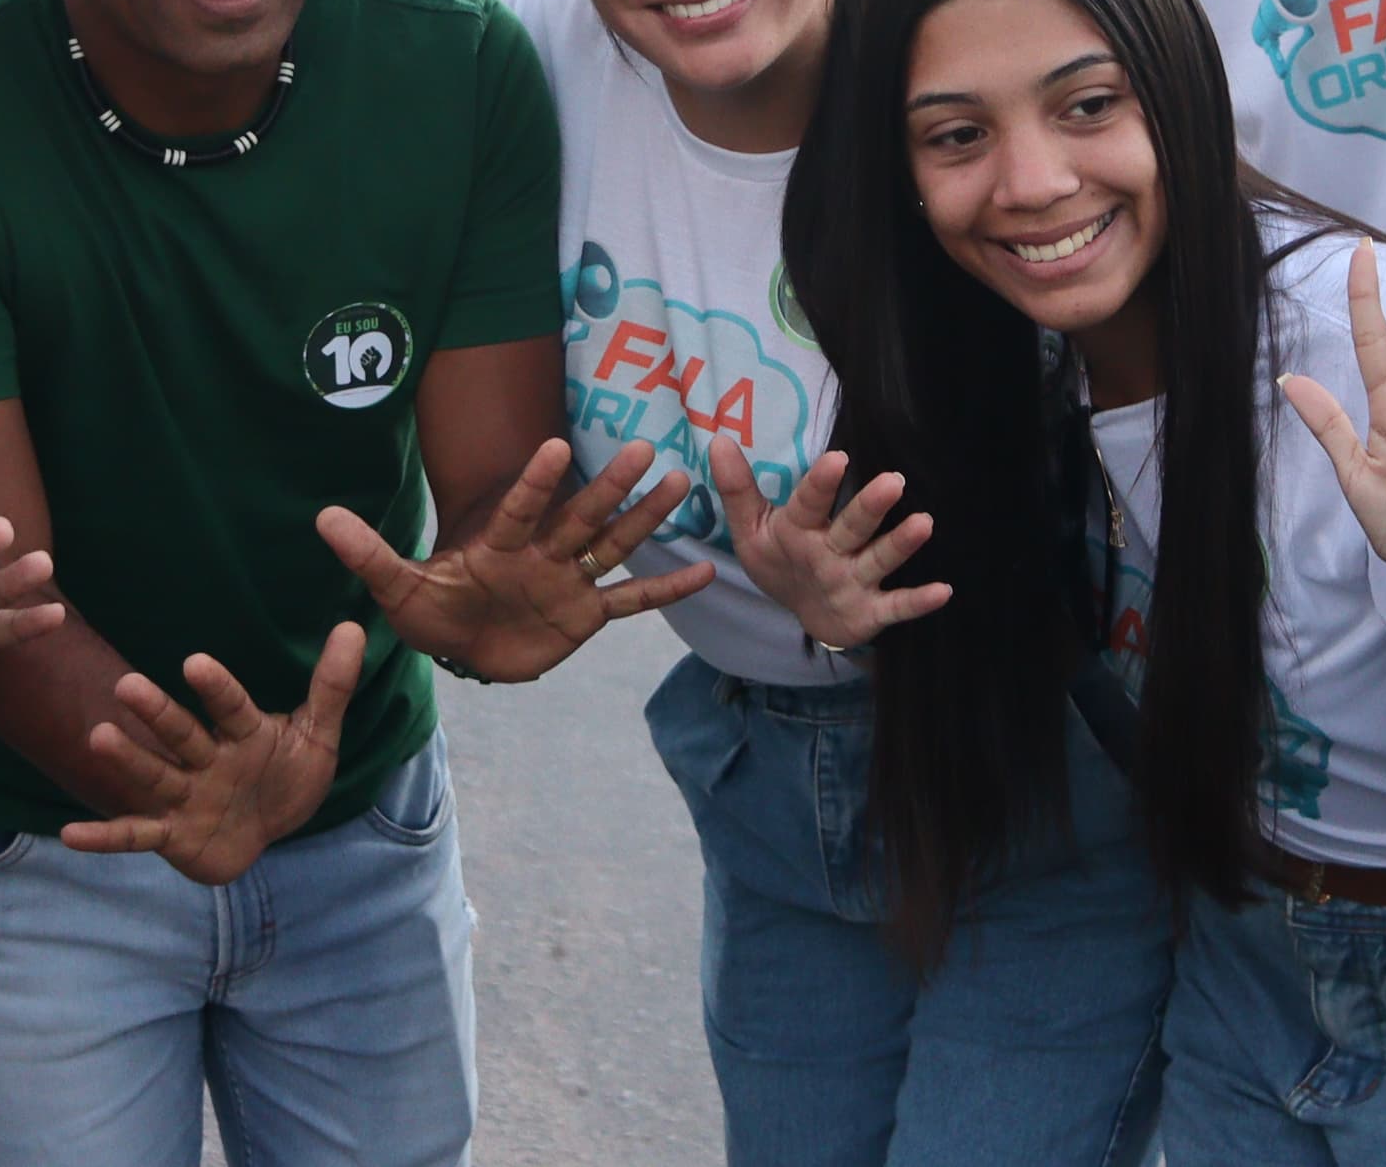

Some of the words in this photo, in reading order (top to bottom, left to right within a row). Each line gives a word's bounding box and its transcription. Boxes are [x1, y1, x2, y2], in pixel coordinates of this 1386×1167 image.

[335, 322, 352, 334] EU
[355, 317, 380, 332] SOU
[321, 331, 393, 385] 10
[593, 319, 754, 449] FALA
